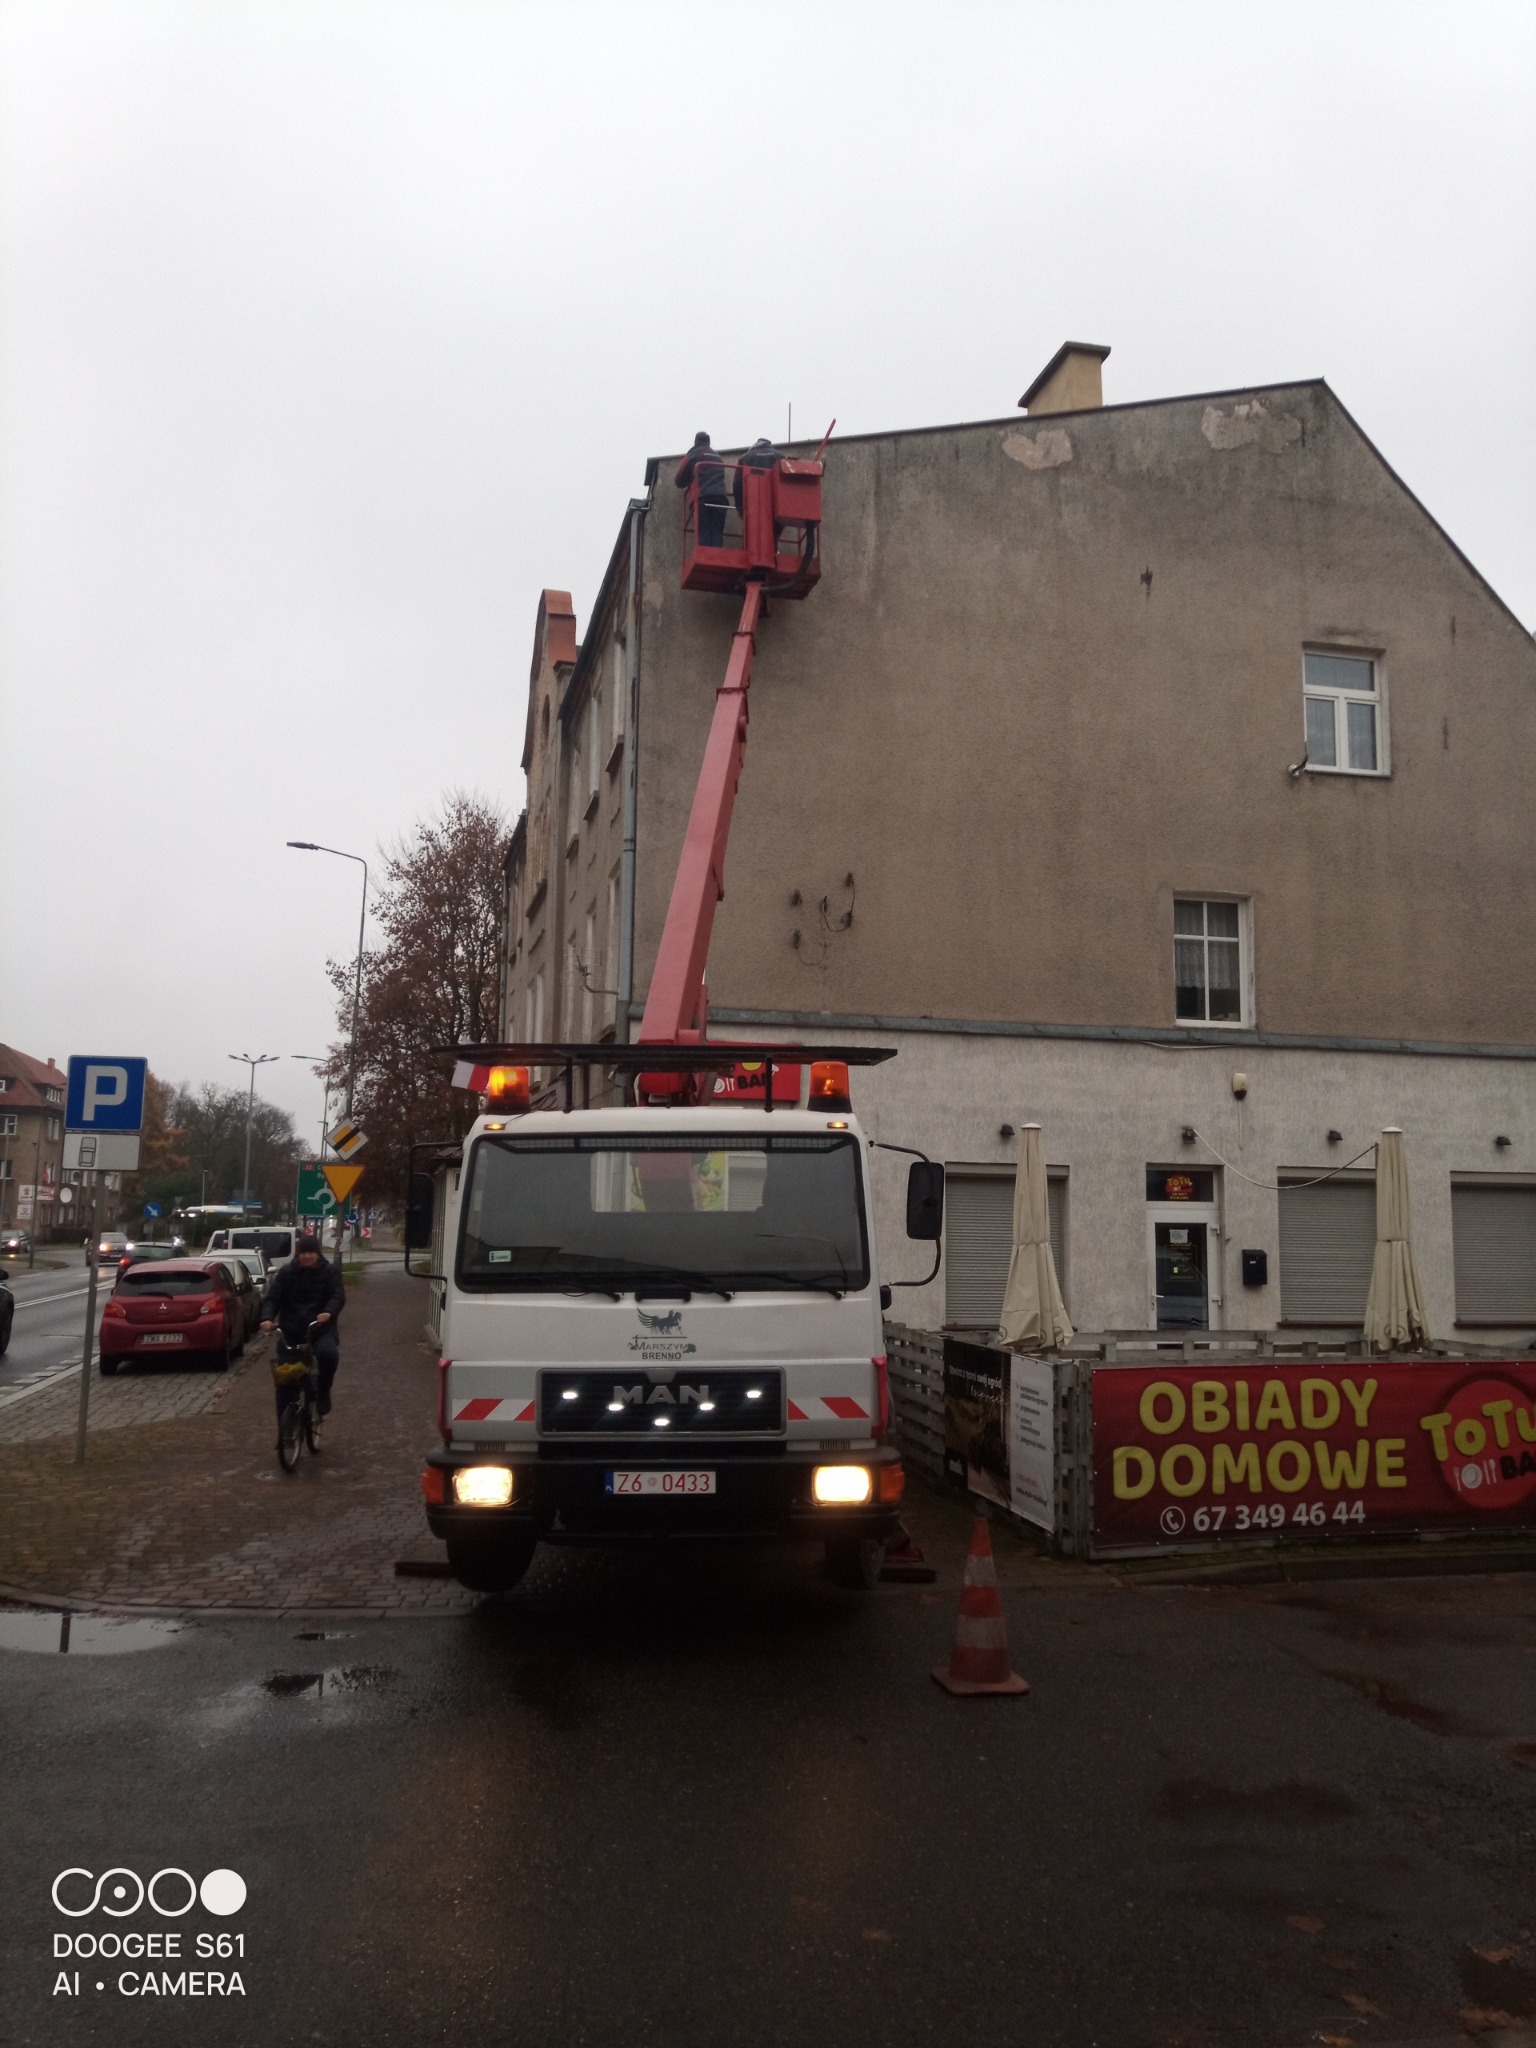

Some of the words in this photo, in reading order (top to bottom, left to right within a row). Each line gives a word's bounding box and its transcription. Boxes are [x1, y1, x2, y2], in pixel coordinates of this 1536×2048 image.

[82, 1065, 128, 1121] P
[642, 1352, 682, 1360] BRENNO
[613, 1385, 709, 1404] MAN
[1139, 1378, 1378, 1435] OBIADY
[617, 1473, 642, 1492] Z6
[662, 1473, 710, 1492] 0433
[1113, 1438, 1408, 1500] DOMOWE
[1193, 1506, 1227, 1531] 67
[1235, 1503, 1285, 1530] 349
[1292, 1501, 1326, 1527] 46
[1332, 1500, 1366, 1524] 44
